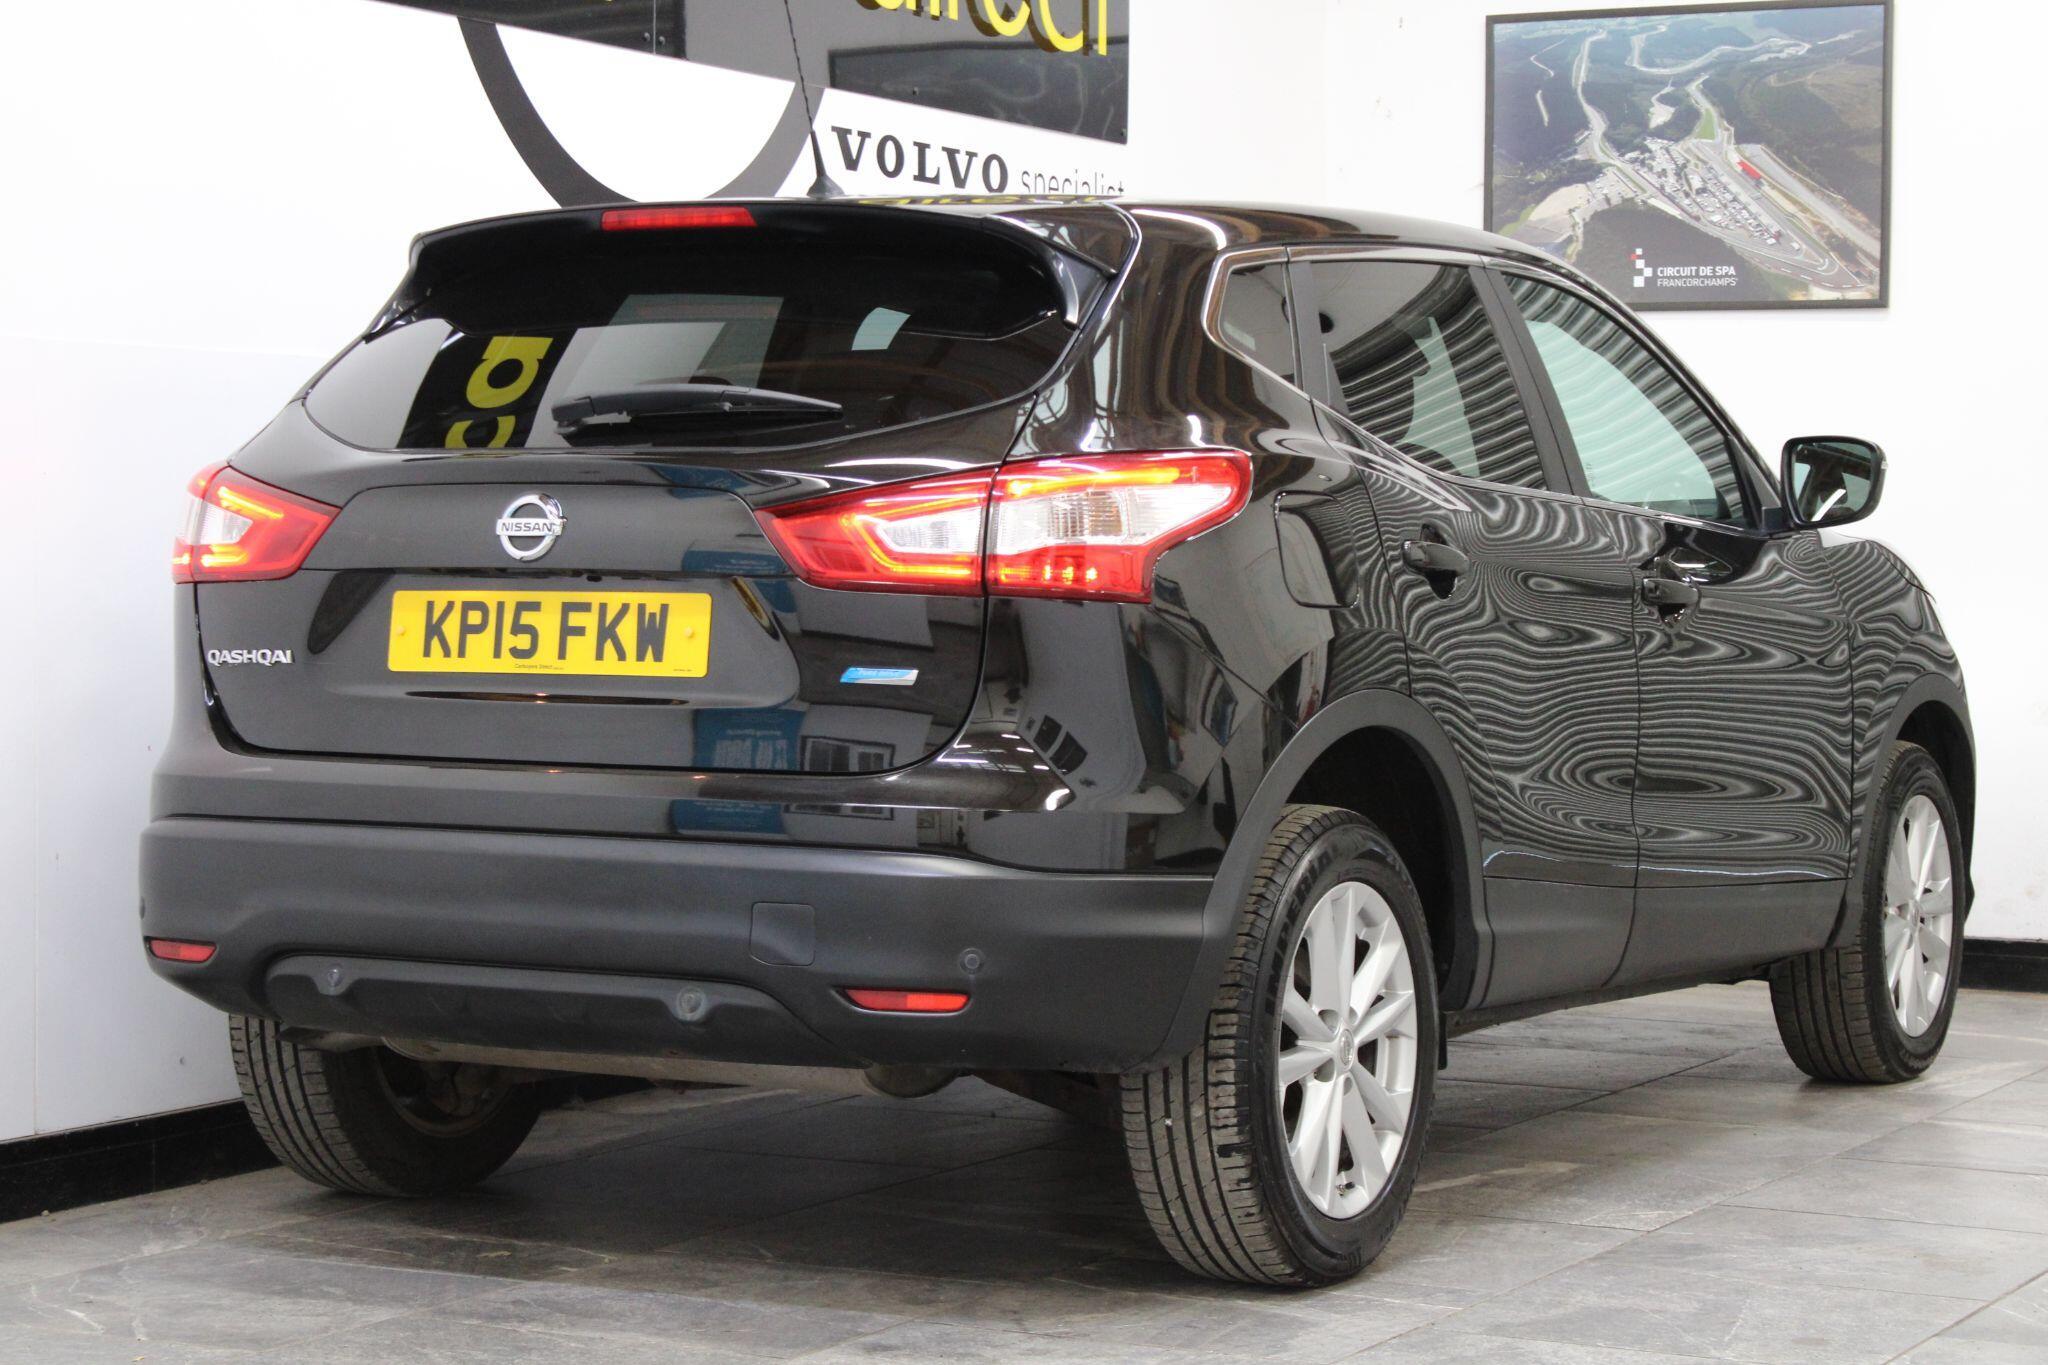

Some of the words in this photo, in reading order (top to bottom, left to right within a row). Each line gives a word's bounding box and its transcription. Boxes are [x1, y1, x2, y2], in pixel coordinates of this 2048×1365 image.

[831, 125, 1009, 194] VOLVO
[1657, 266, 1697, 277] CIRCUIT
[1699, 266, 1714, 276] DE
[1715, 266, 1737, 276] SPA
[1657, 278, 1737, 287] FRANCORCHAMPS
[501, 522, 553, 533] NISSAN
[423, 600, 542, 660] KP15
[557, 602, 670, 663] FKW
[207, 649, 293, 667] QASHQAI
